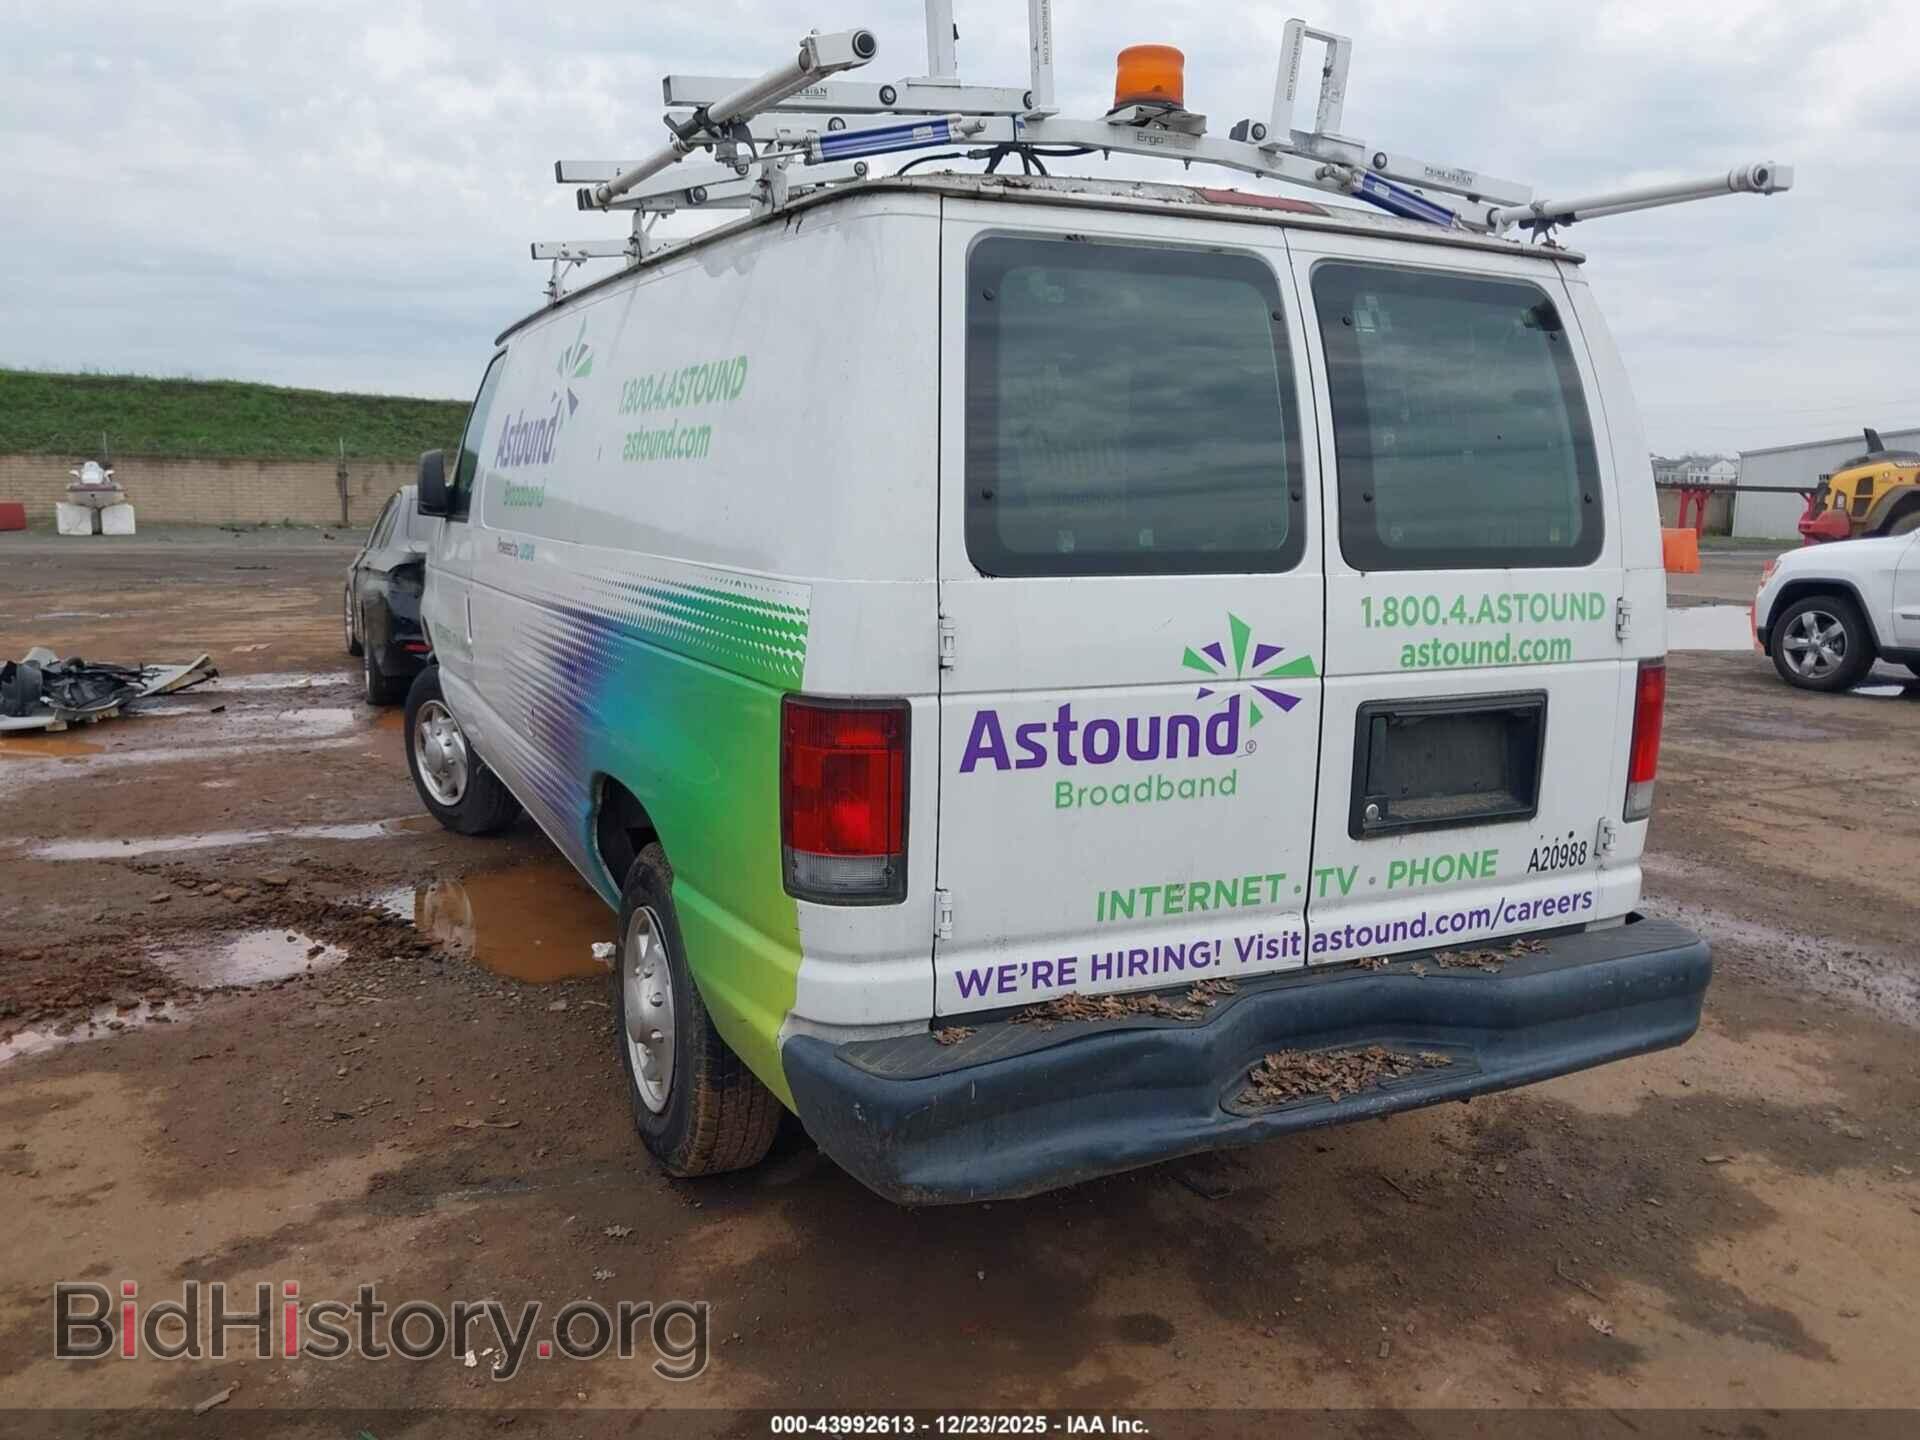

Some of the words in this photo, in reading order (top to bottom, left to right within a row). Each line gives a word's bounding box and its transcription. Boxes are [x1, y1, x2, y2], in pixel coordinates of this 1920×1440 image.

[494, 398, 562, 470] Astound
[622, 417, 712, 461] astound.com
[1361, 592, 1607, 628] 1.800.4.ASTOUND
[1399, 633, 1573, 669] astound.com
[959, 693, 1242, 774] Astound
[1053, 768, 1239, 809] Broadband
[1526, 841, 1588, 875] A20988
[1095, 872, 1288, 923] INTERNET
[1314, 865, 1361, 898] TV
[1386, 848, 1500, 890] PHONE
[1089, 939, 1223, 983] HIRING!
[1234, 929, 1303, 963] Visit
[1310, 888, 1594, 955] astound.com/careers
